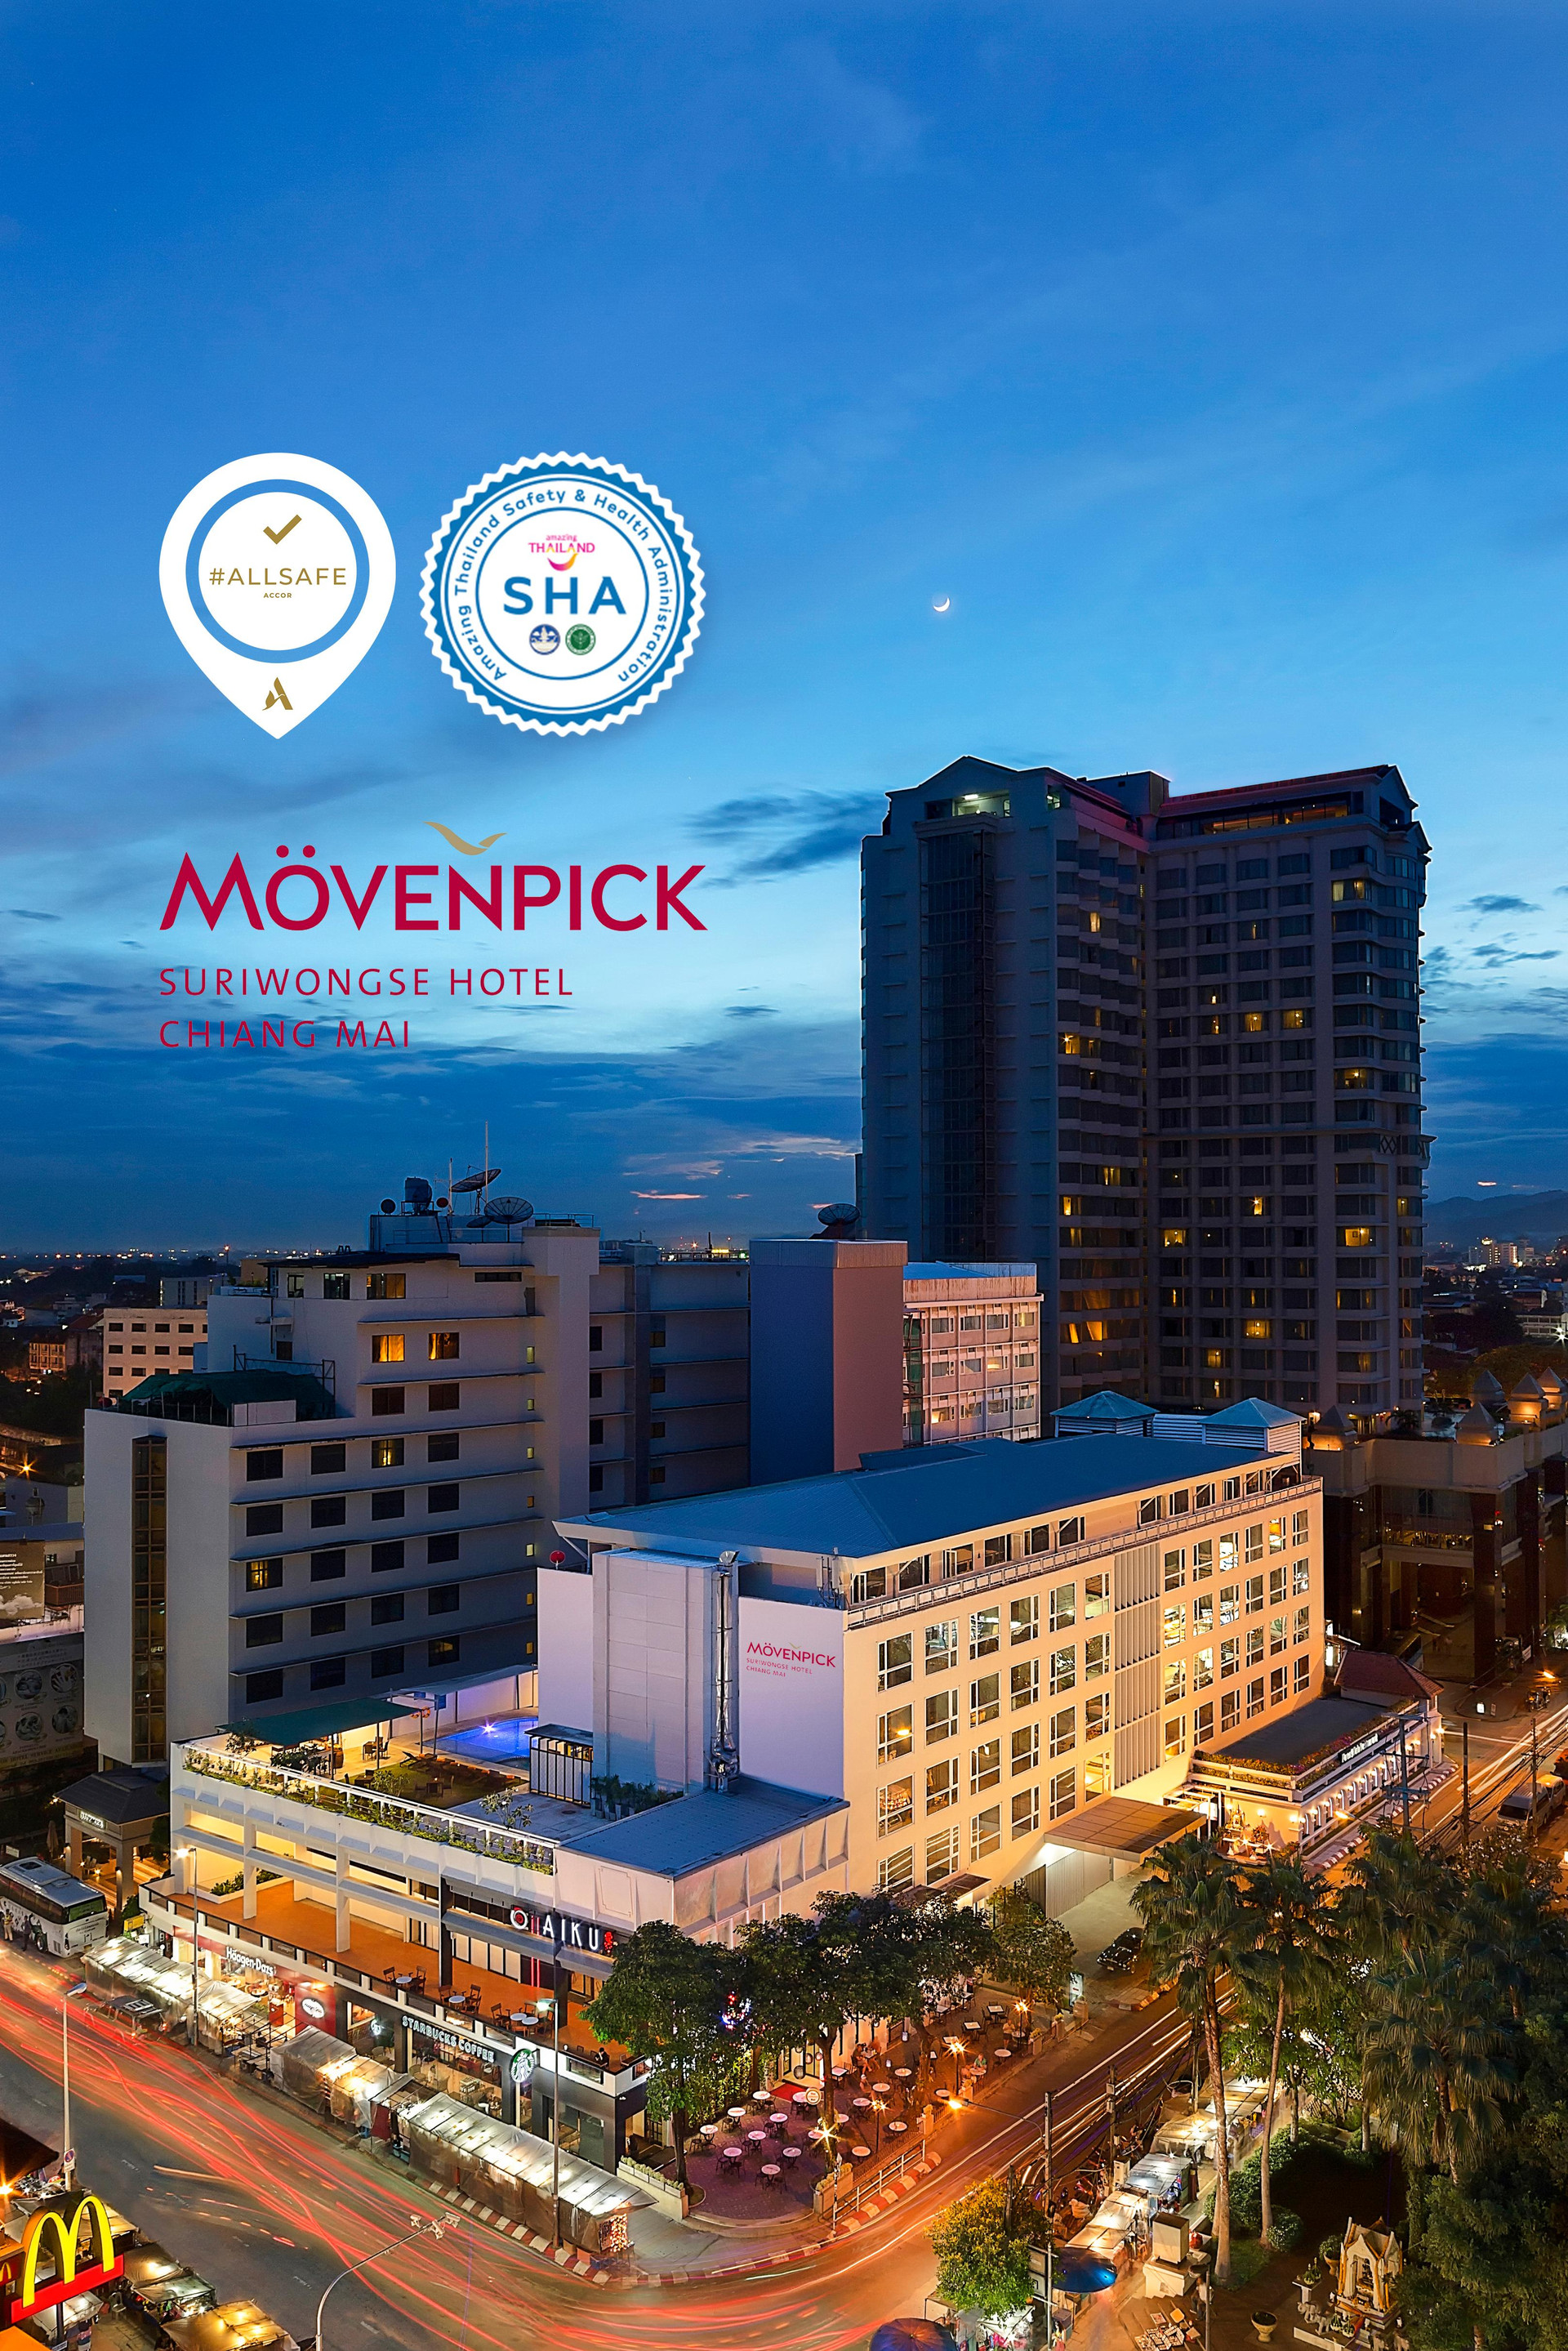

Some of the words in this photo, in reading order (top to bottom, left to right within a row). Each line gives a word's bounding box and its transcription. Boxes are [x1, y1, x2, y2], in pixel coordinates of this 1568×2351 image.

[746, 1641, 836, 1668] MÖVENPICK
[746, 1657, 788, 1671] SURIWONGSE
[791, 1666, 813, 1675] HOTEL
[746, 1665, 771, 1675] CHIANG
[542, 1914, 599, 1951] AIKU
[225, 1945, 274, 1977] Häagen-Dazs
[402, 2015, 457, 2046] STARBUCKS
[458, 2039, 495, 2063] COFFEE
